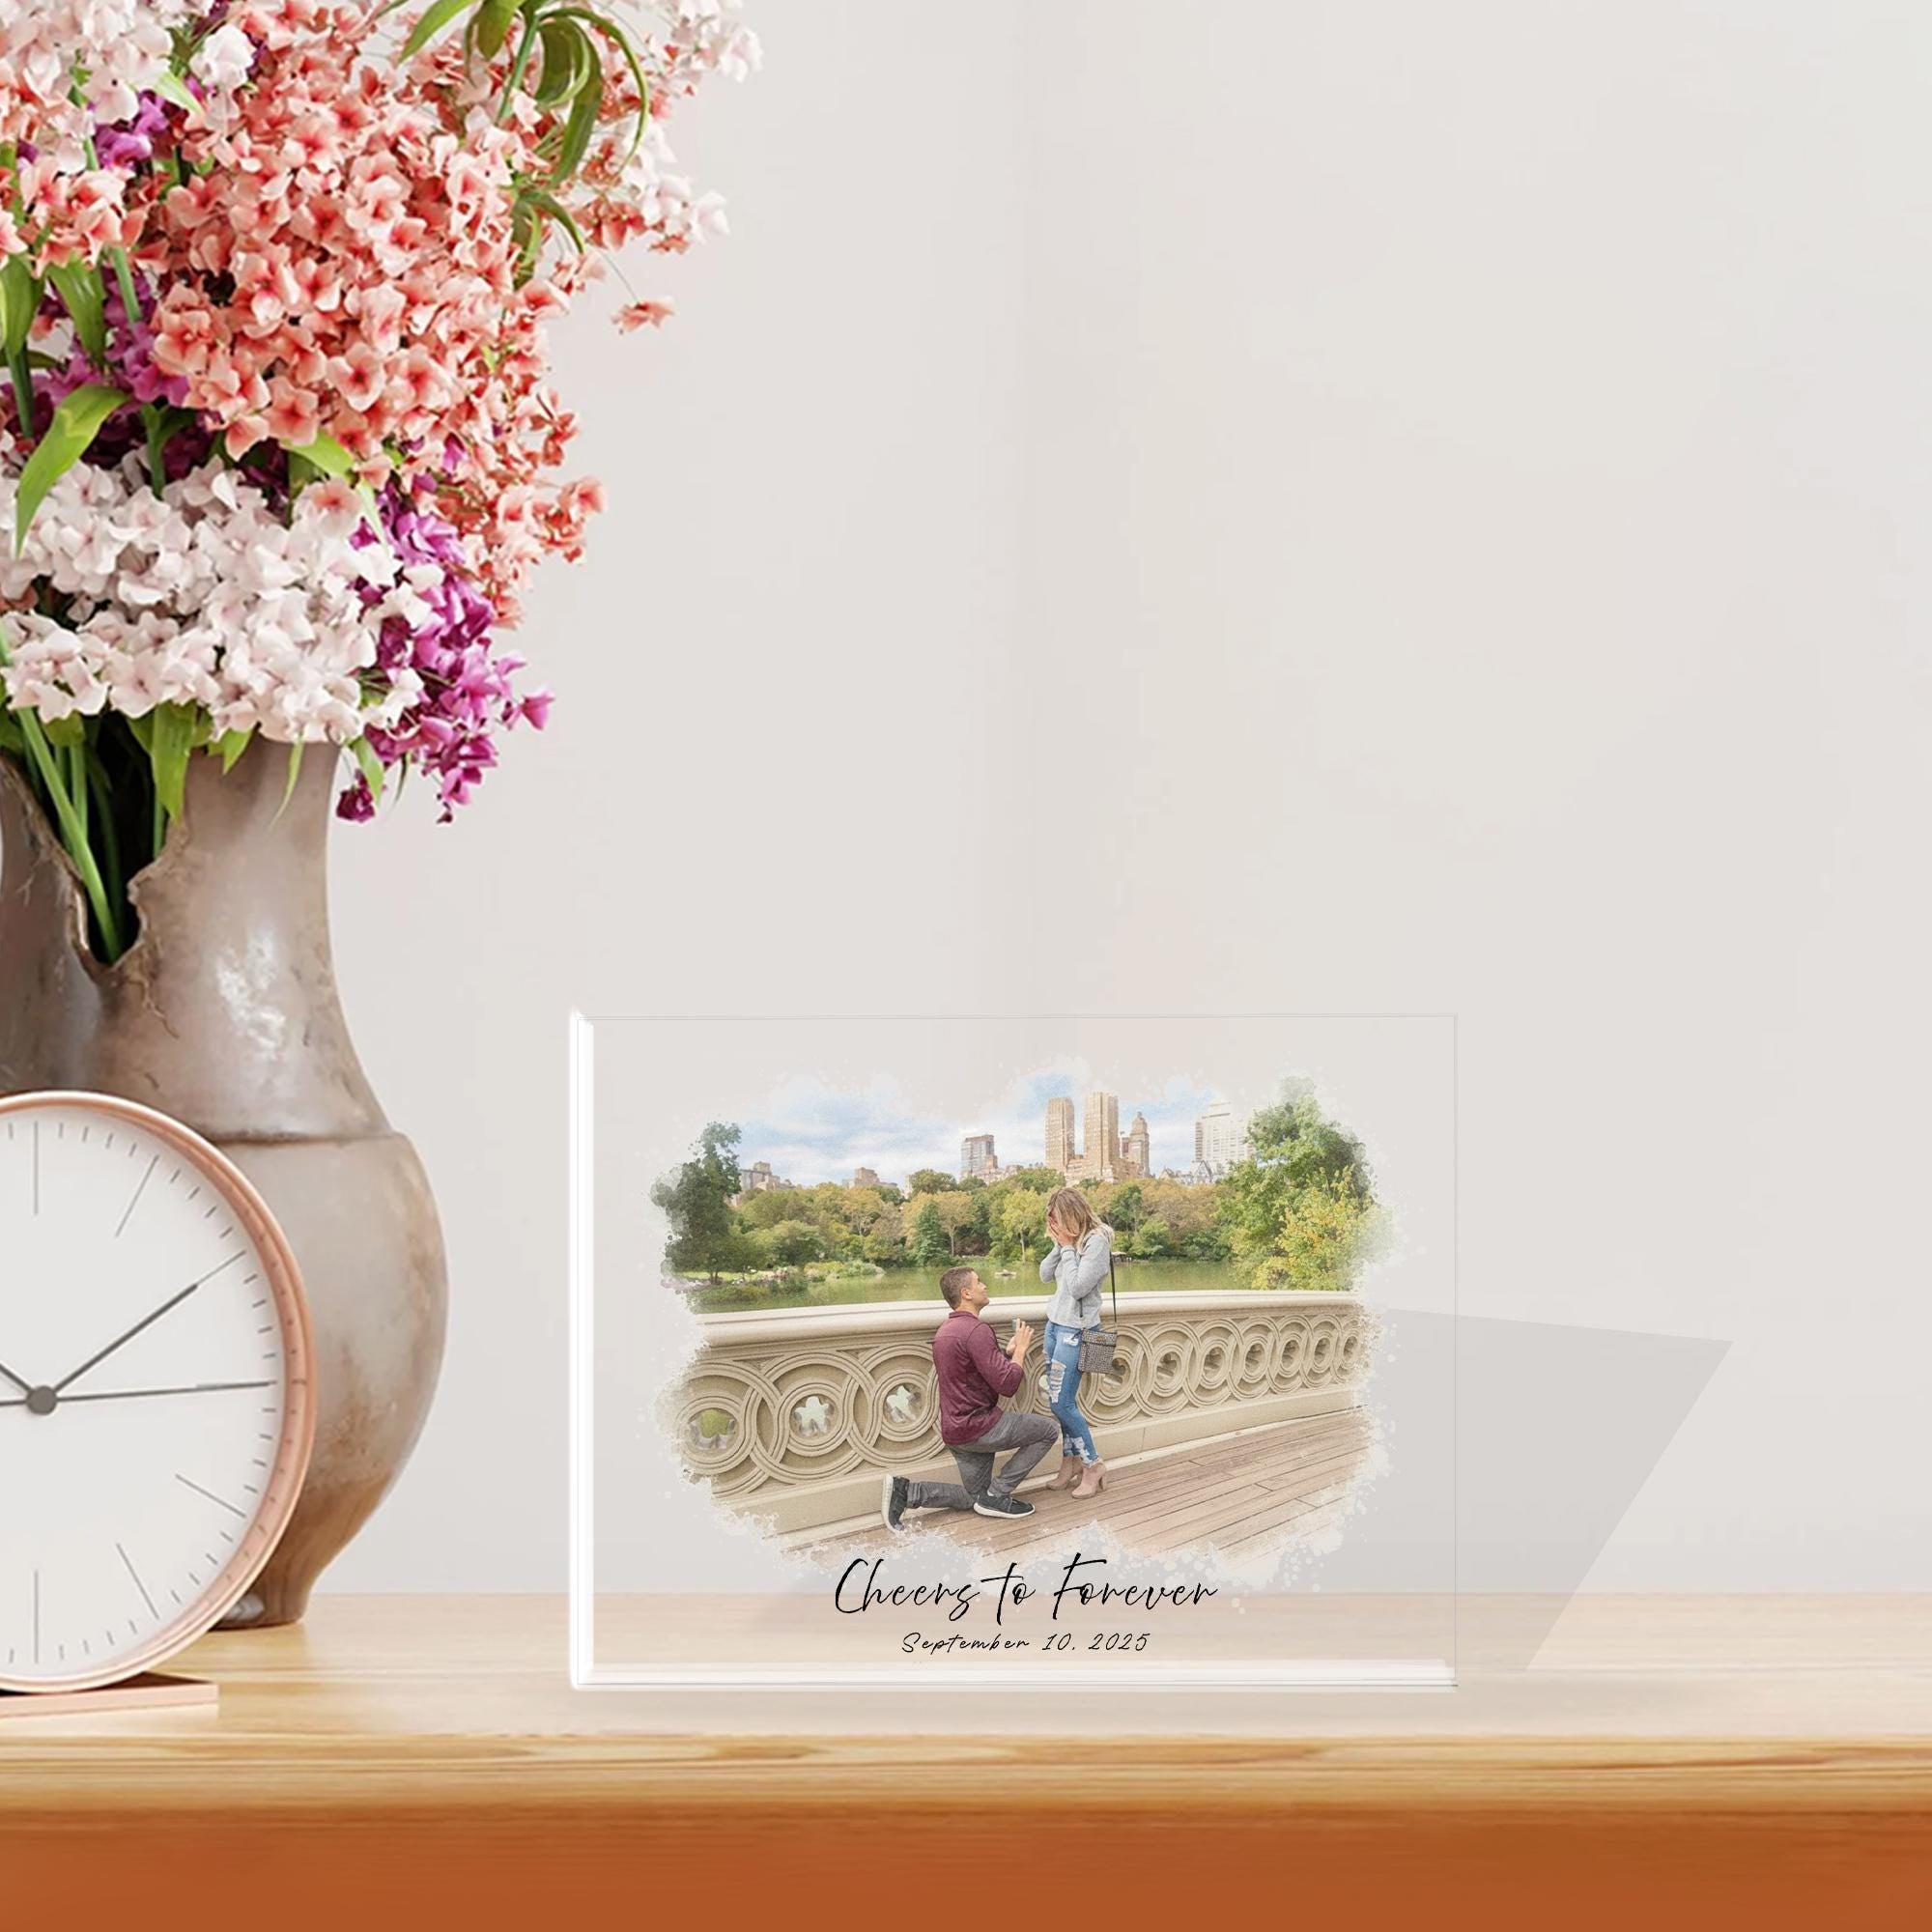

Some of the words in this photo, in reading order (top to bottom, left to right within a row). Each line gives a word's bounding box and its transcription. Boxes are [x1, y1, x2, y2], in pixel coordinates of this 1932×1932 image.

[835, 1557, 980, 1622] Cheers
[980, 1562, 1037, 1626] to
[1053, 1552, 1218, 1621] Forever
[901, 1632, 1030, 1655] September
[1088, 1633, 1151, 1652] 2025
